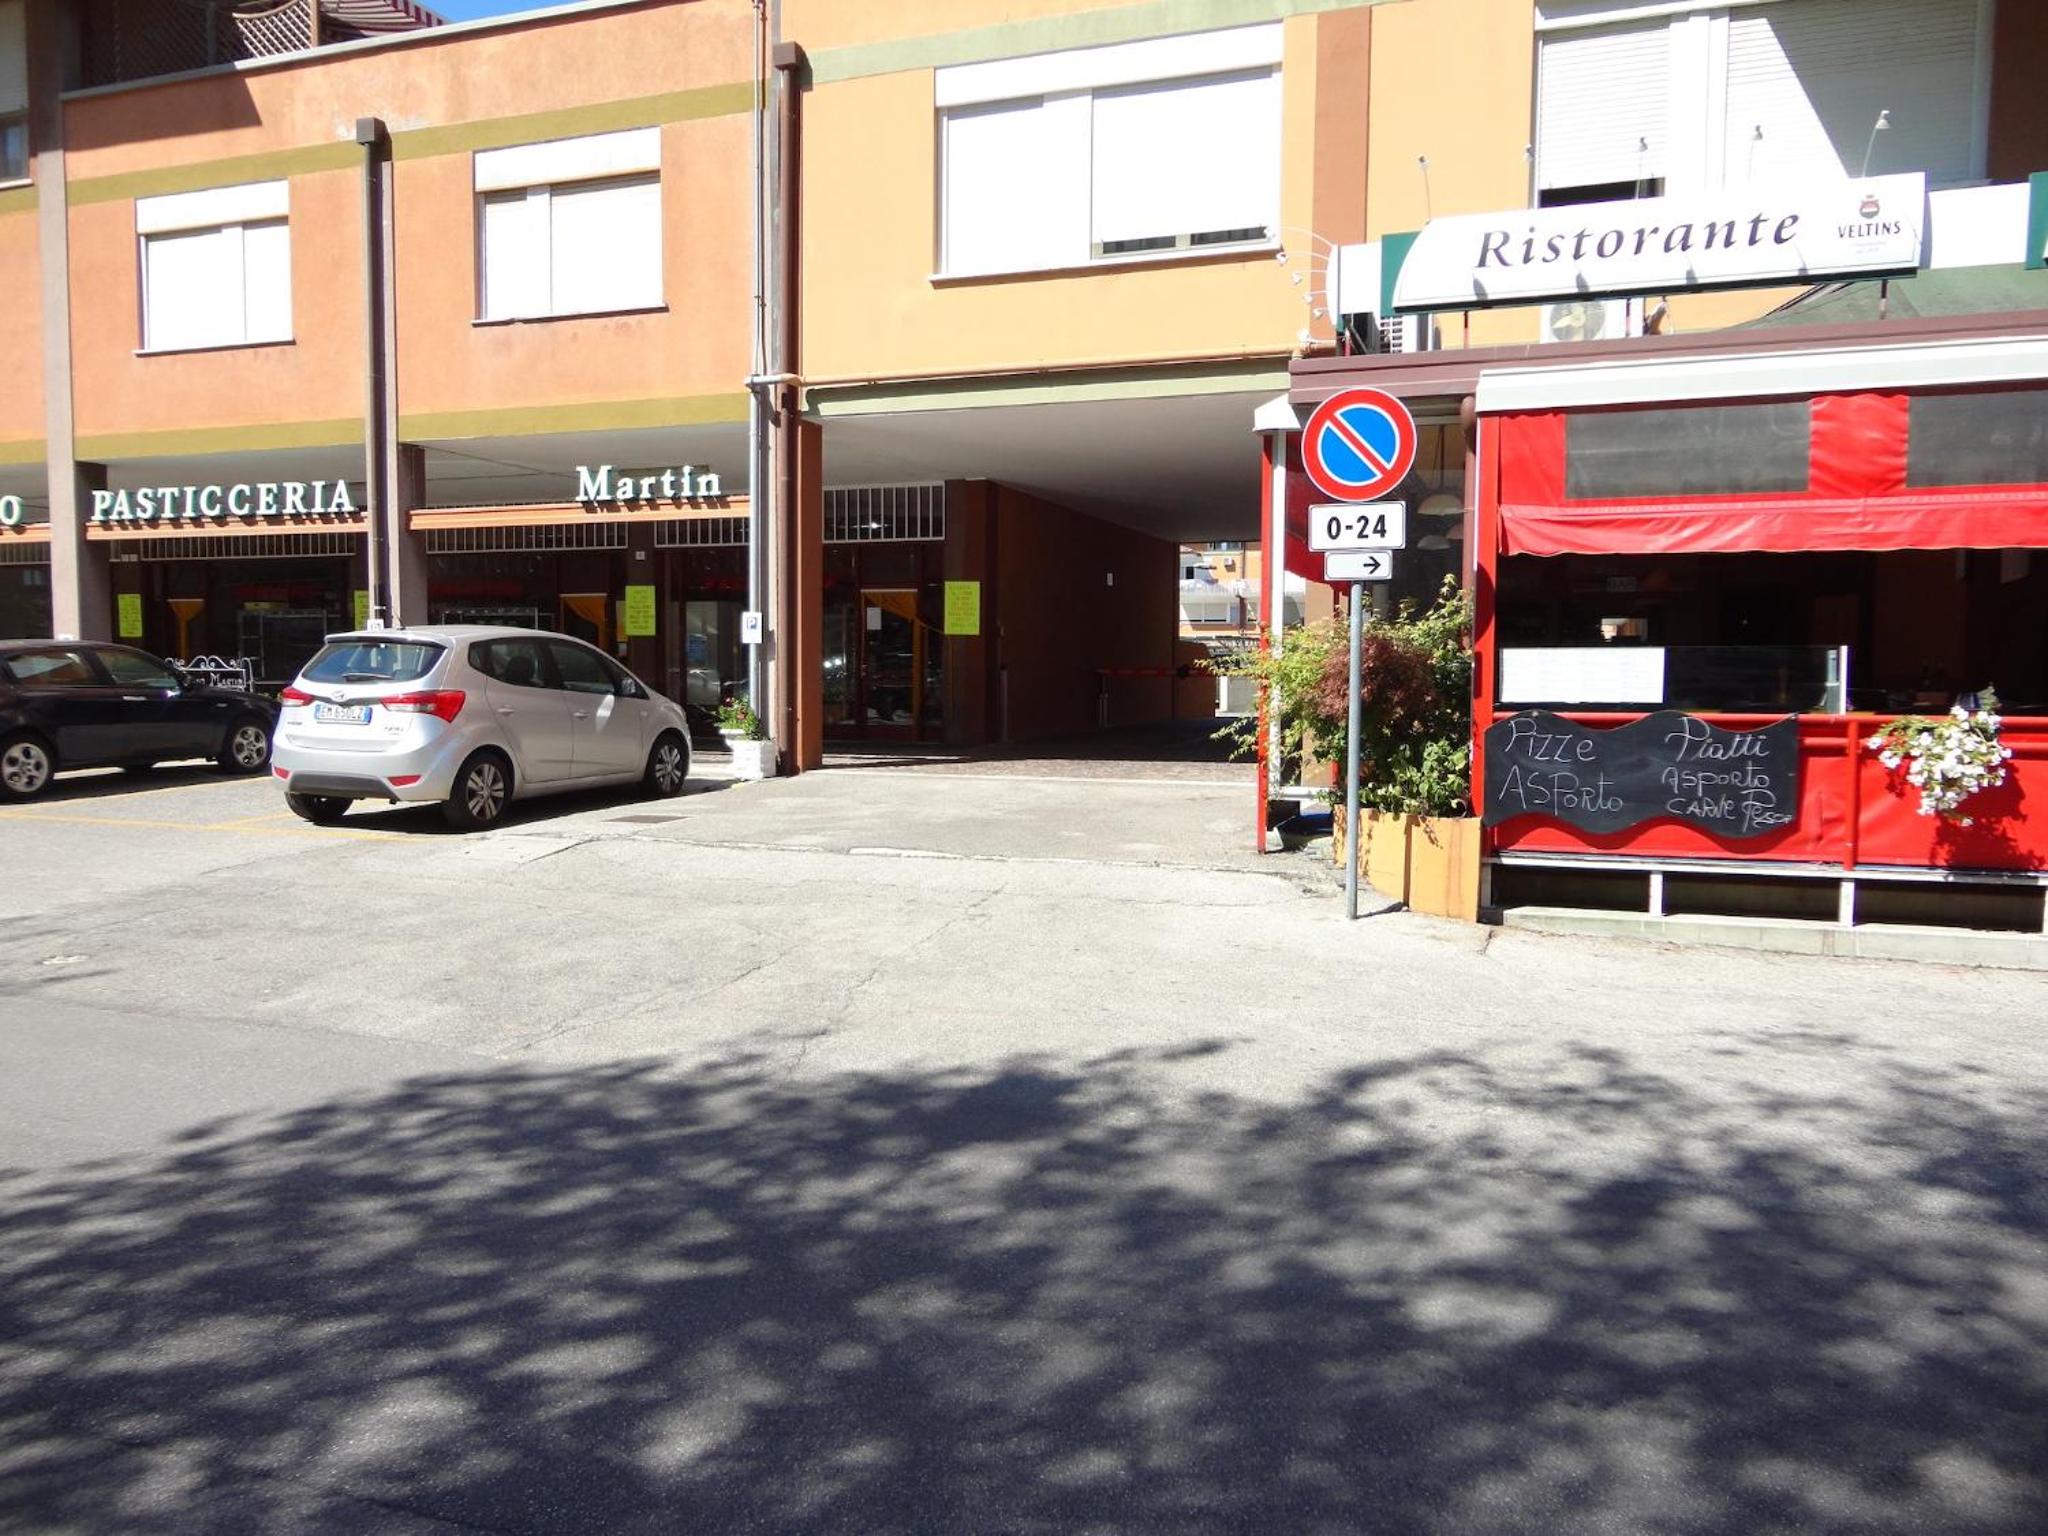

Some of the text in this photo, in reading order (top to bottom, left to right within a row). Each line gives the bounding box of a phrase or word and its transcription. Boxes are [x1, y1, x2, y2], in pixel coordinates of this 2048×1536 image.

[1474, 213, 1799, 269] Ristorante
[1838, 221, 1901, 239] VELTINS
[91, 480, 355, 521] PASTICCERIA
[575, 464, 722, 502] Martin
[1327, 514, 1387, 540] 0-24
[1664, 716, 1771, 762] Piatti
